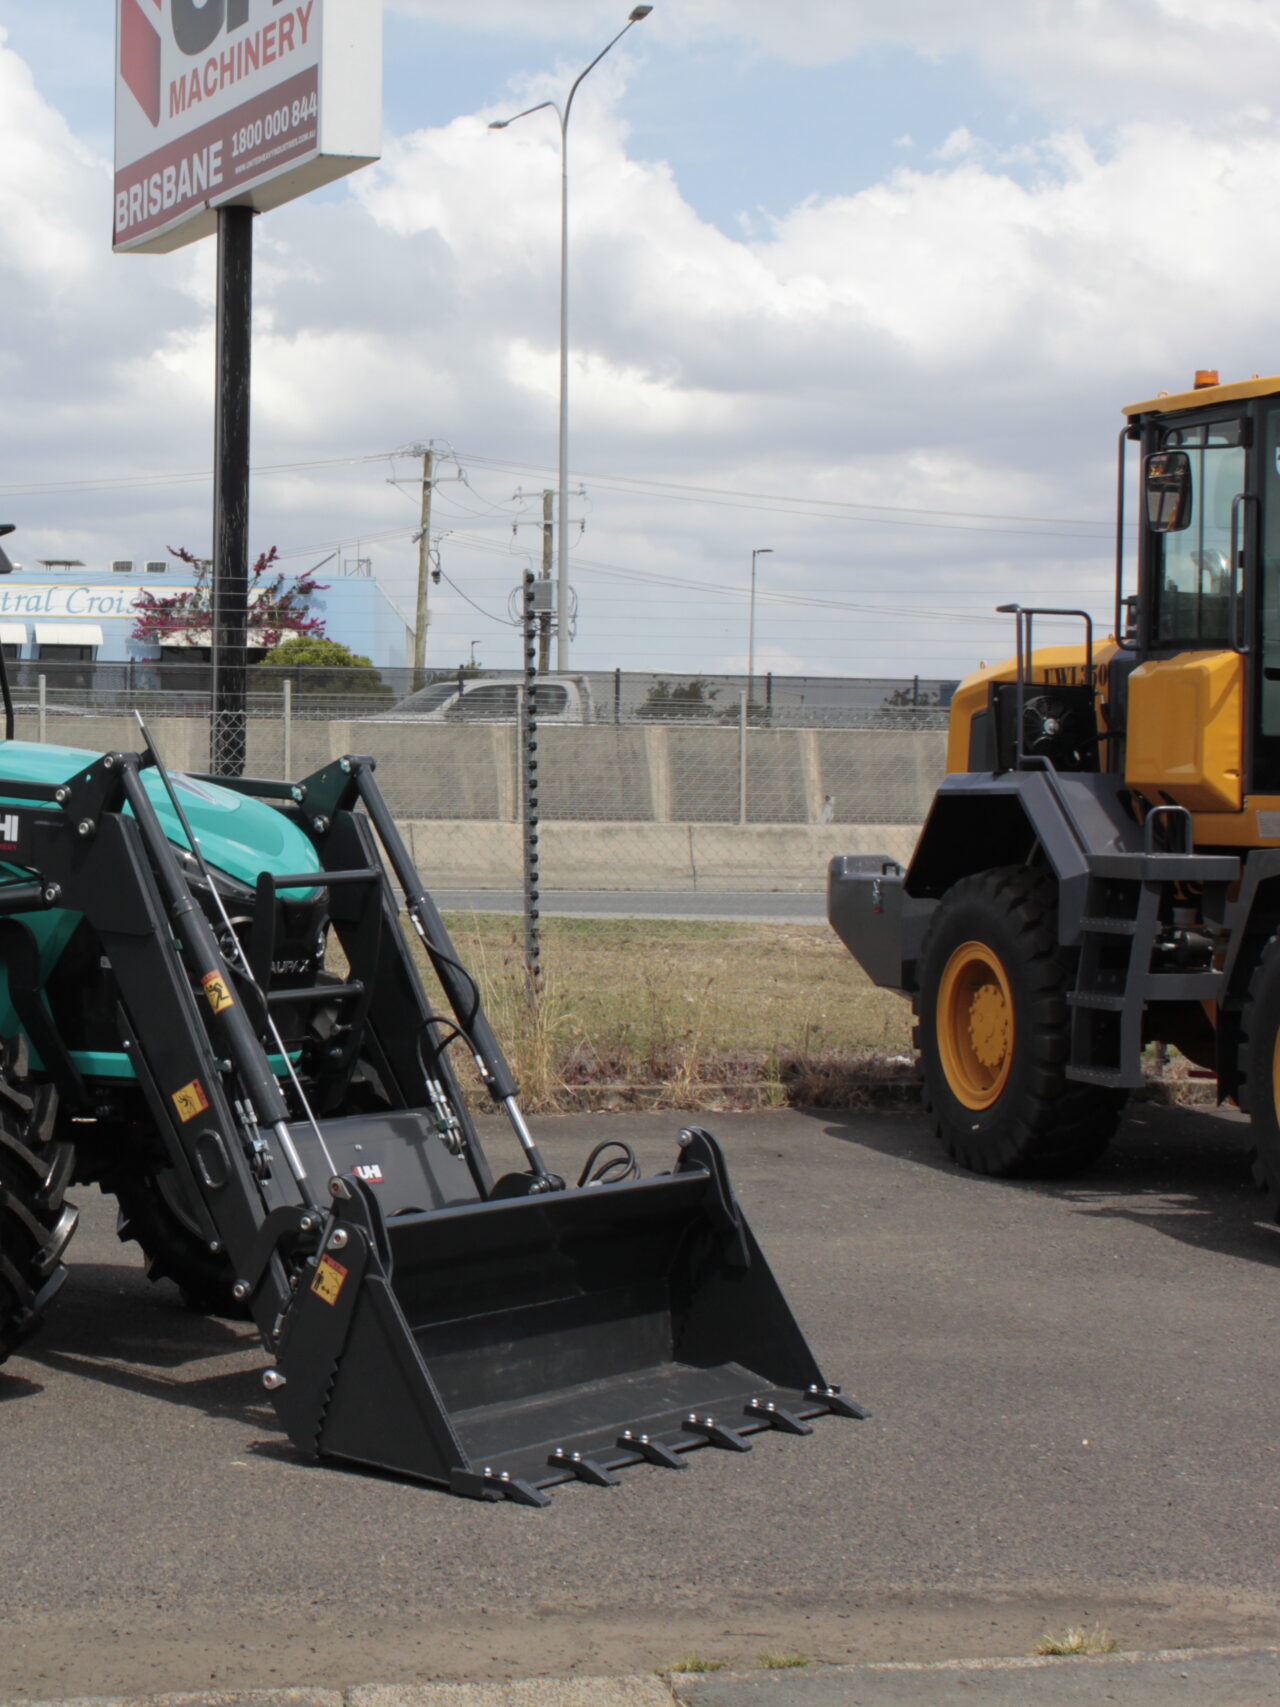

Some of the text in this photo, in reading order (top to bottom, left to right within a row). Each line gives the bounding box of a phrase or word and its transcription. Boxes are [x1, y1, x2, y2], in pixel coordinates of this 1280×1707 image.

[170, 1, 314, 118] MACHINERY
[232, 91, 317, 157] 1800 000 844
[115, 139, 223, 233] BRISBANE
[357, 1164, 383, 1180] UHI
